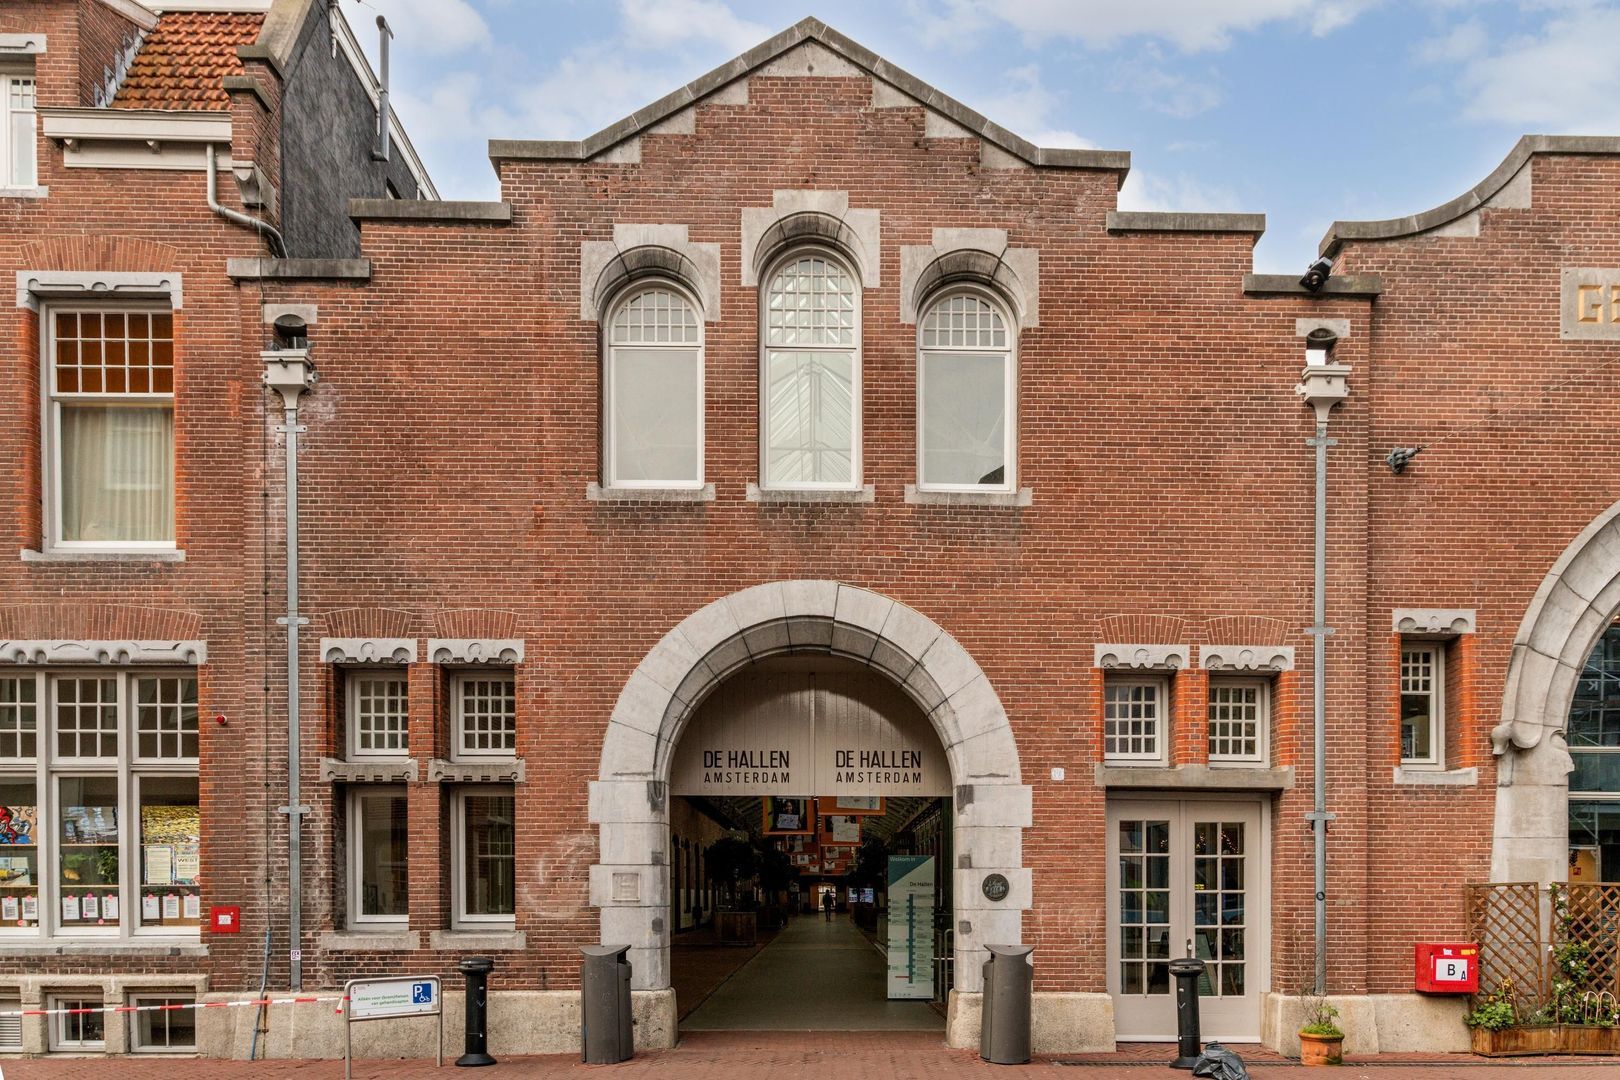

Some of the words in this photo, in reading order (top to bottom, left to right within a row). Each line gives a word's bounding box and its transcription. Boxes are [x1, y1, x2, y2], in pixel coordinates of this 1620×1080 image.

[703, 750, 723, 769] DE
[728, 750, 790, 769] HALLEN
[836, 750, 855, 769] DE
[860, 750, 921, 769] HALLEN
[704, 772, 790, 783] AMSTERDAM
[836, 772, 921, 783] AMSTERDAM
[1448, 964, 1456, 976] B
[1461, 971, 1466, 980] A
[414, 985, 423, 997] P
